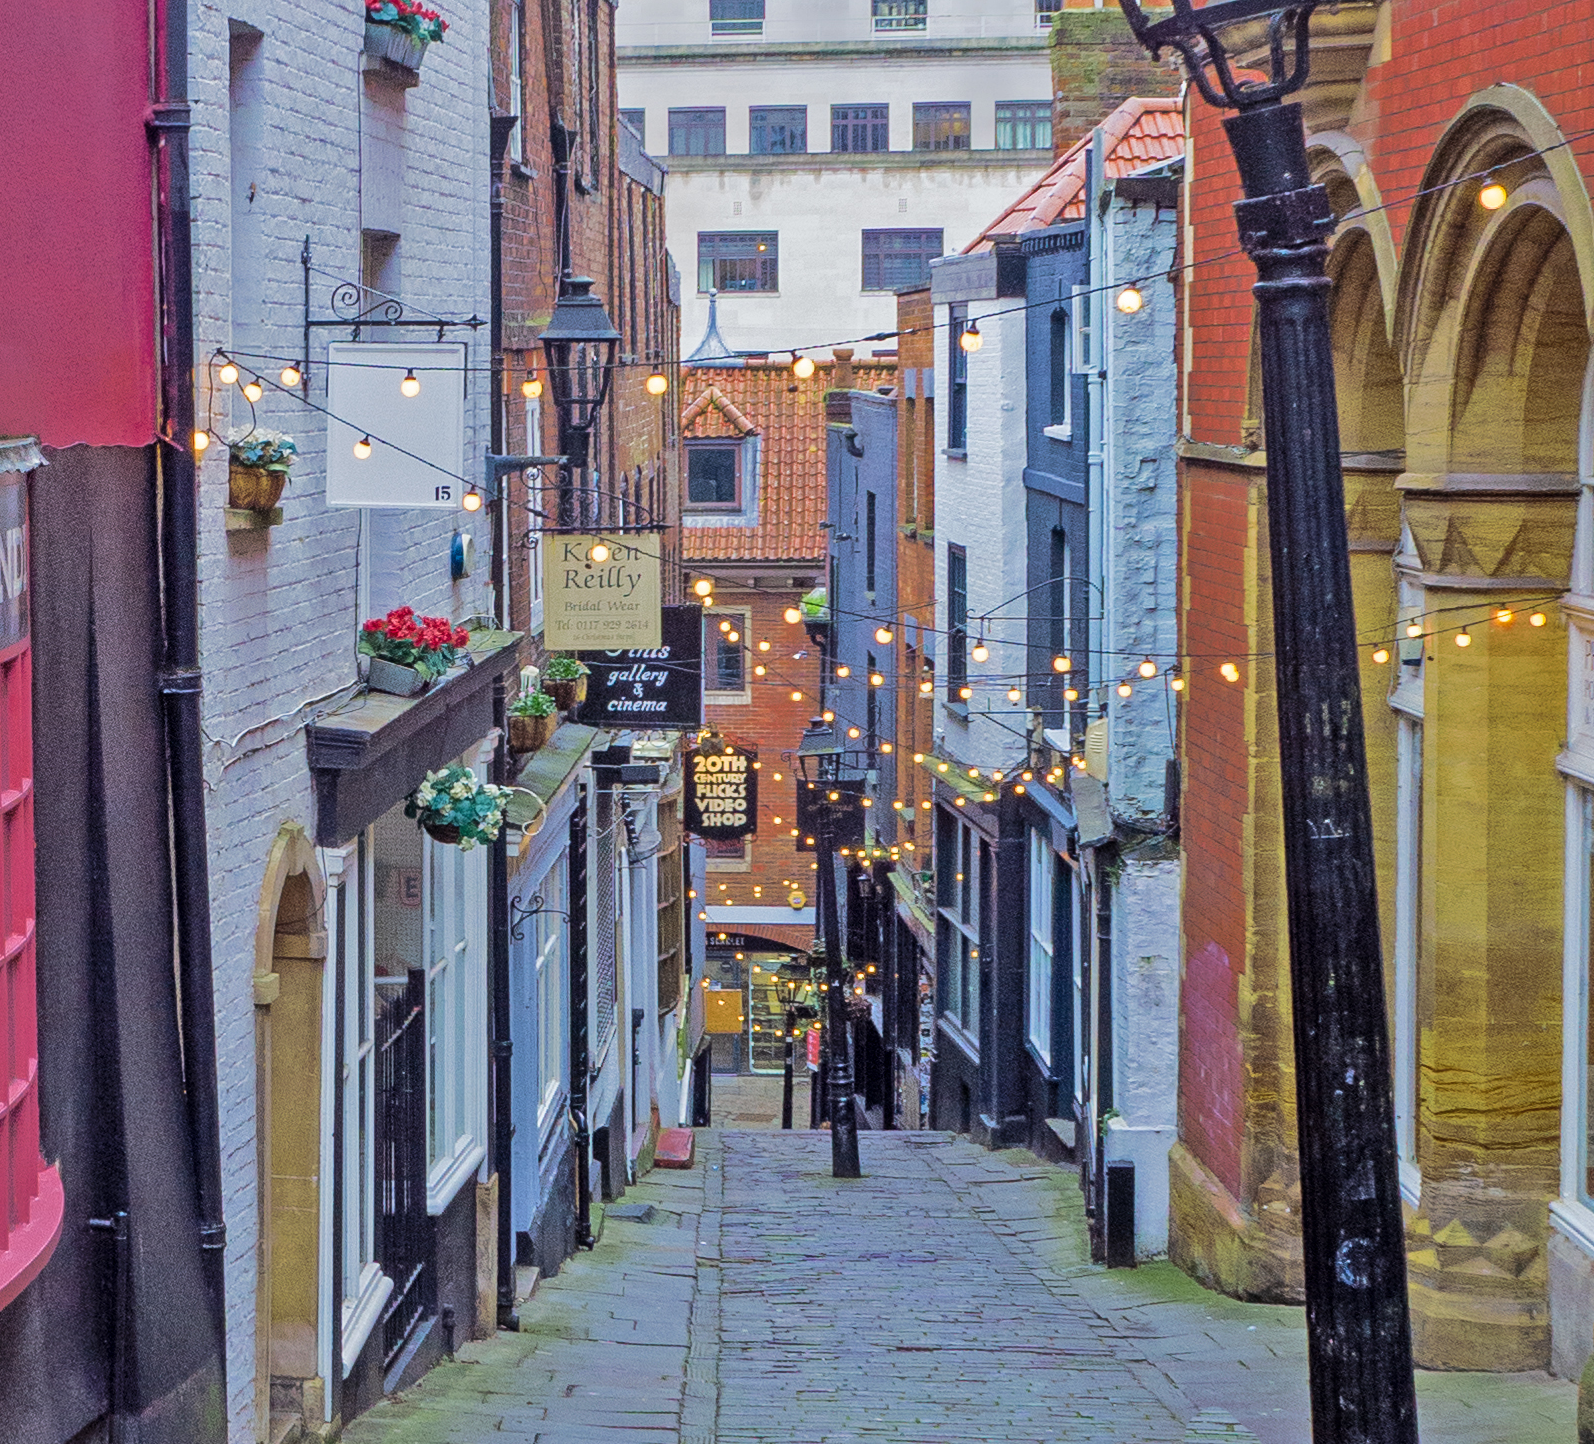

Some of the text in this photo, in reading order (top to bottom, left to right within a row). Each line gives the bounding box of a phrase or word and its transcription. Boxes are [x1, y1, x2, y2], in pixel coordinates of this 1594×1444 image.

[435, 485, 451, 501] 15
[562, 542, 642, 562] Ken
[563, 566, 642, 597] Reilly
[564, 600, 641, 612] Bridal Wear
[607, 664, 668, 686] gallery
[633, 682, 644, 698] &
[607, 696, 668, 712] cinema
[693, 755, 747, 772] 20TH
[693, 772, 748, 784] CENTURY
[696, 783, 747, 798] FLICKS
[694, 798, 747, 812] VIDEO
[701, 812, 747, 827] SHOP
